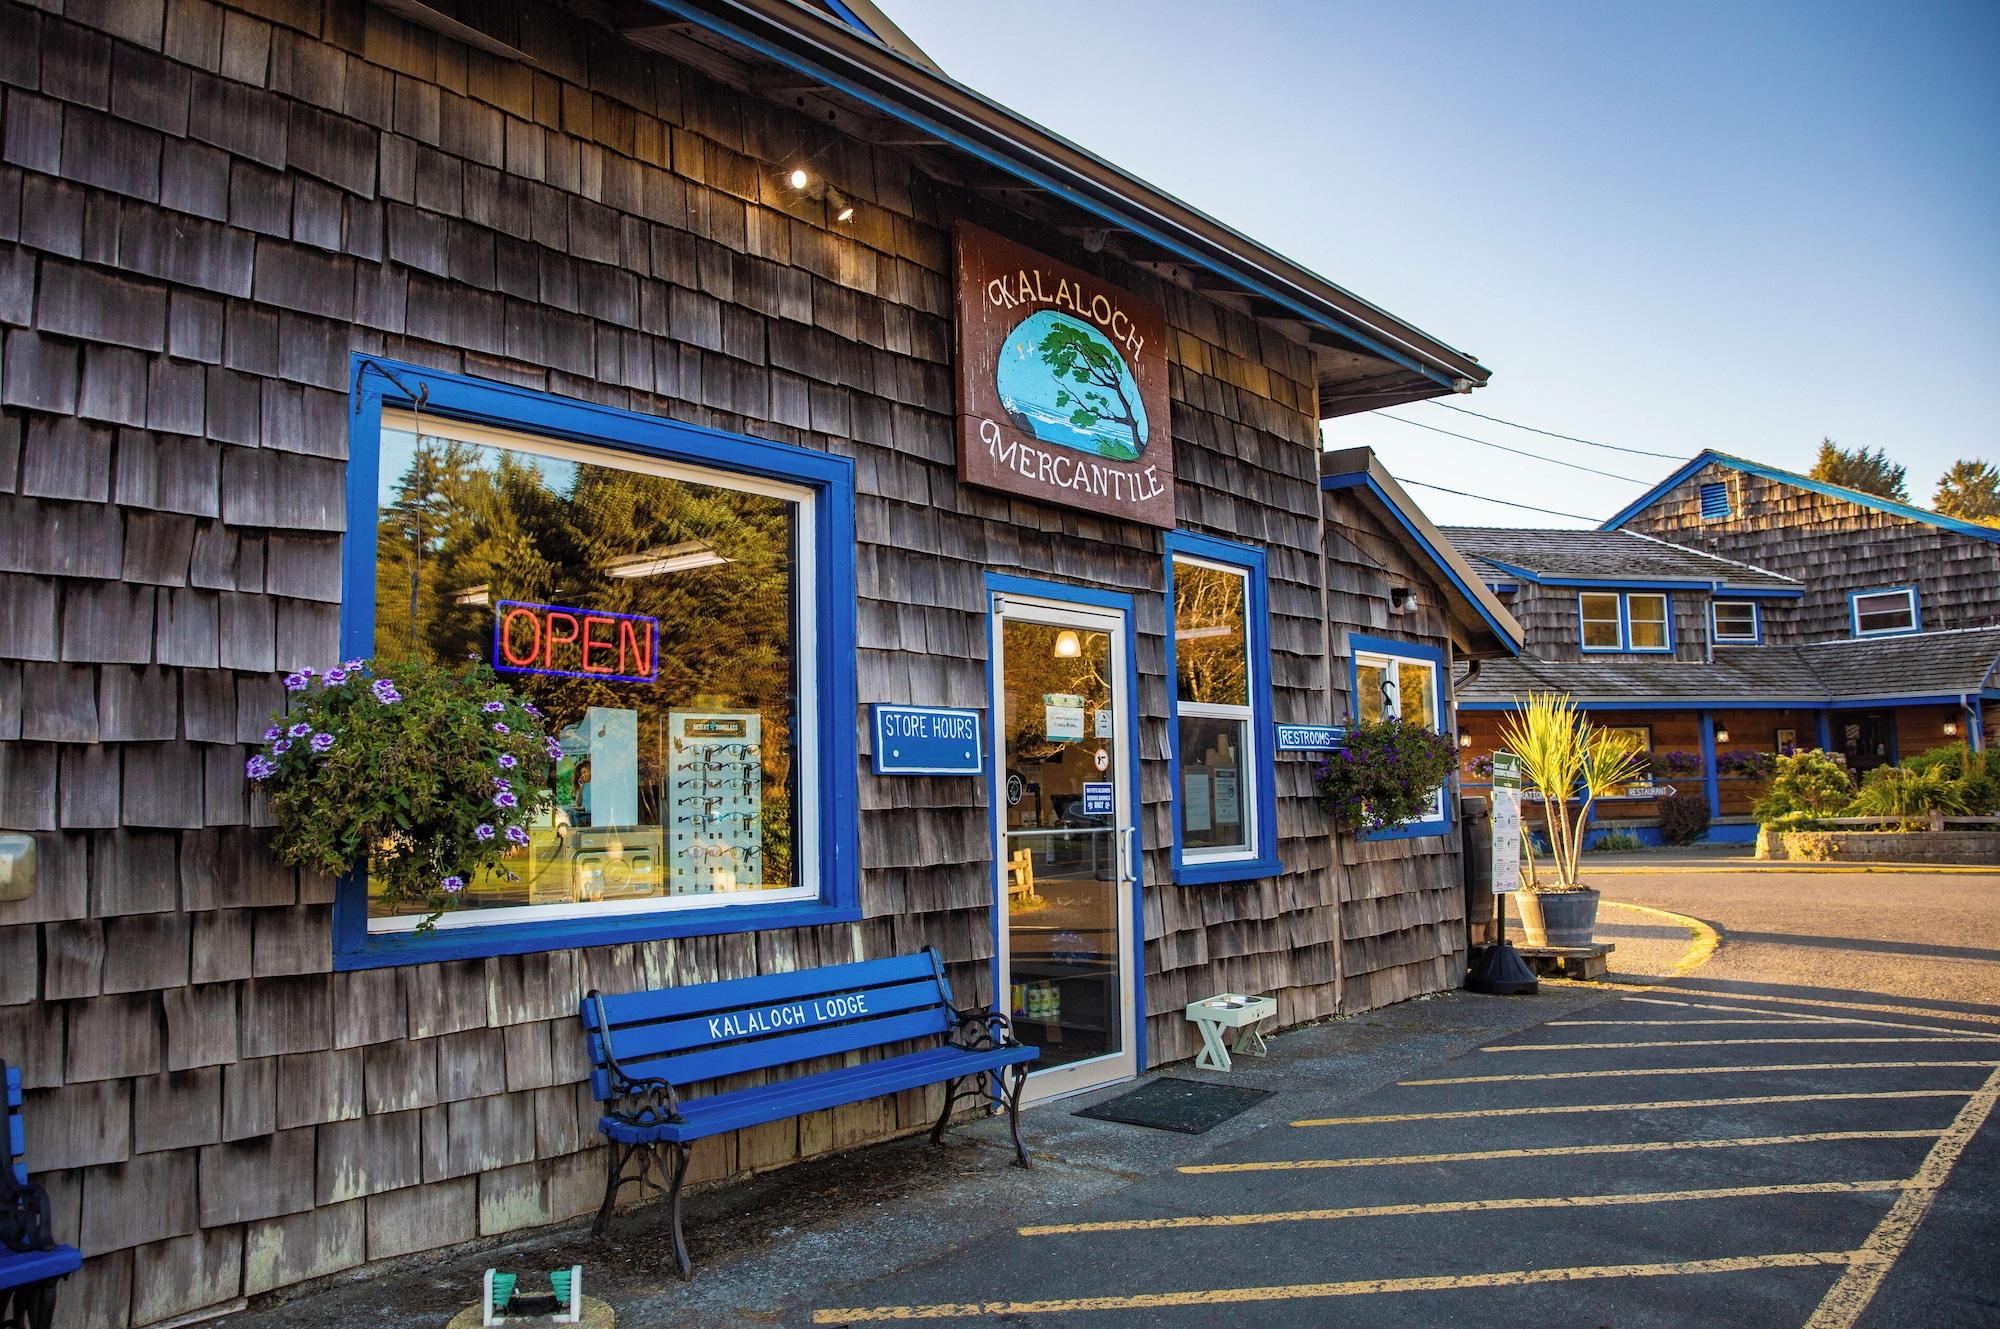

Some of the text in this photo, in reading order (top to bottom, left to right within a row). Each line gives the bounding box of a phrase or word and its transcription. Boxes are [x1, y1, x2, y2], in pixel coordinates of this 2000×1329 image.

[988, 270, 1144, 362] KALALOCH
[980, 418, 1165, 502] MERCANTILE
[502, 608, 651, 676] OPEN
[885, 714, 973, 740] STORE HOURS
[1281, 730, 1331, 746] RESTROOMS
[1628, 786, 1667, 796] RESTAURANT
[708, 994, 869, 1039] KALALOCH LODGE
